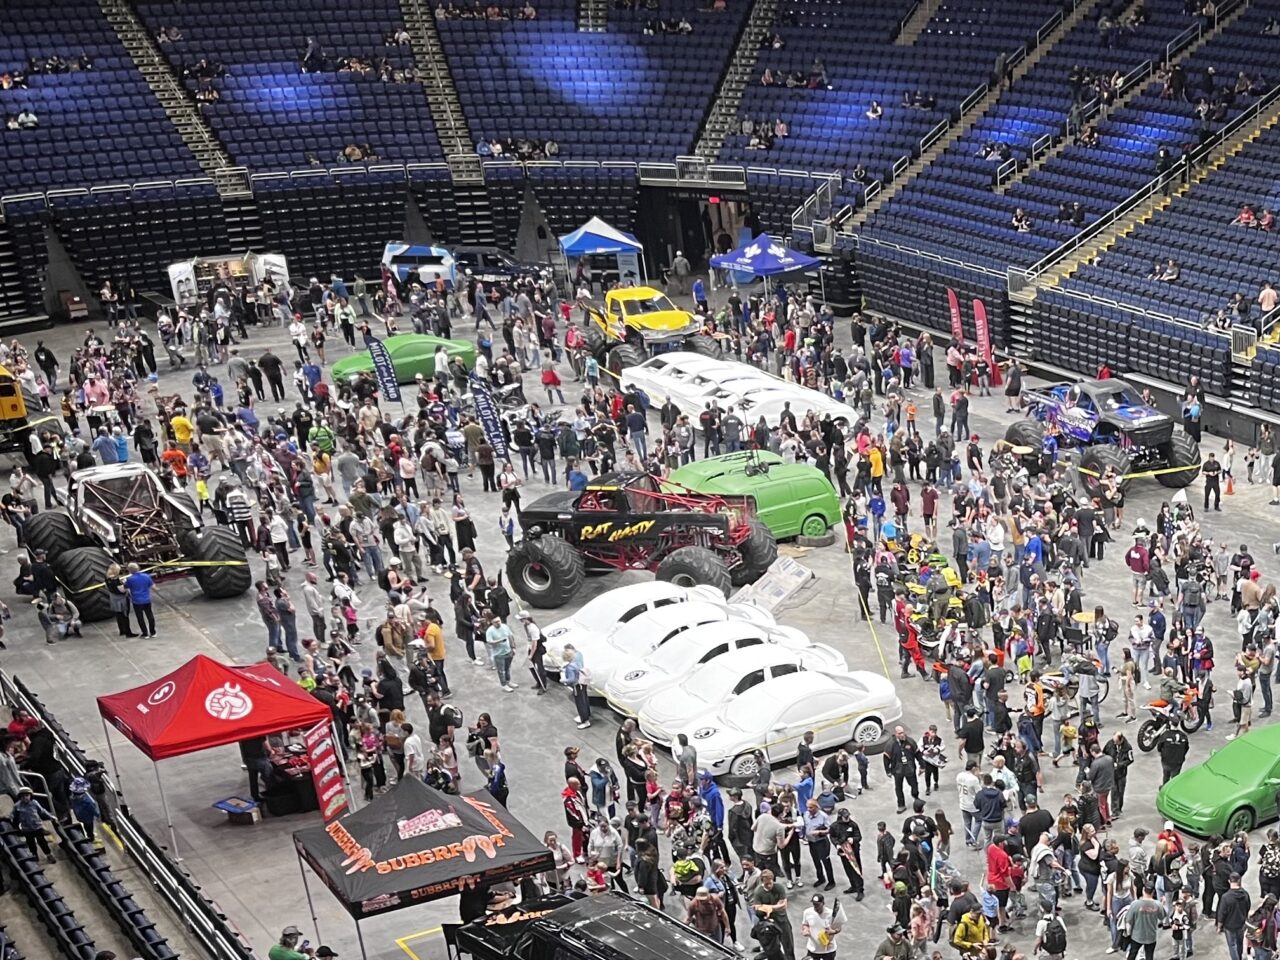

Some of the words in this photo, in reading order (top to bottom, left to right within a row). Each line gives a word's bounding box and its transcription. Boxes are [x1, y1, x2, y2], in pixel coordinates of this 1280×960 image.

[368, 341, 386, 368] MILOT
[383, 376, 398, 399] LAND
[475, 393, 493, 421] MILOT
[489, 432, 505, 455] LAND
[580, 522, 613, 541] RAT
[608, 520, 656, 542] NASTY
[375, 833, 506, 875] SUBERFOOT
